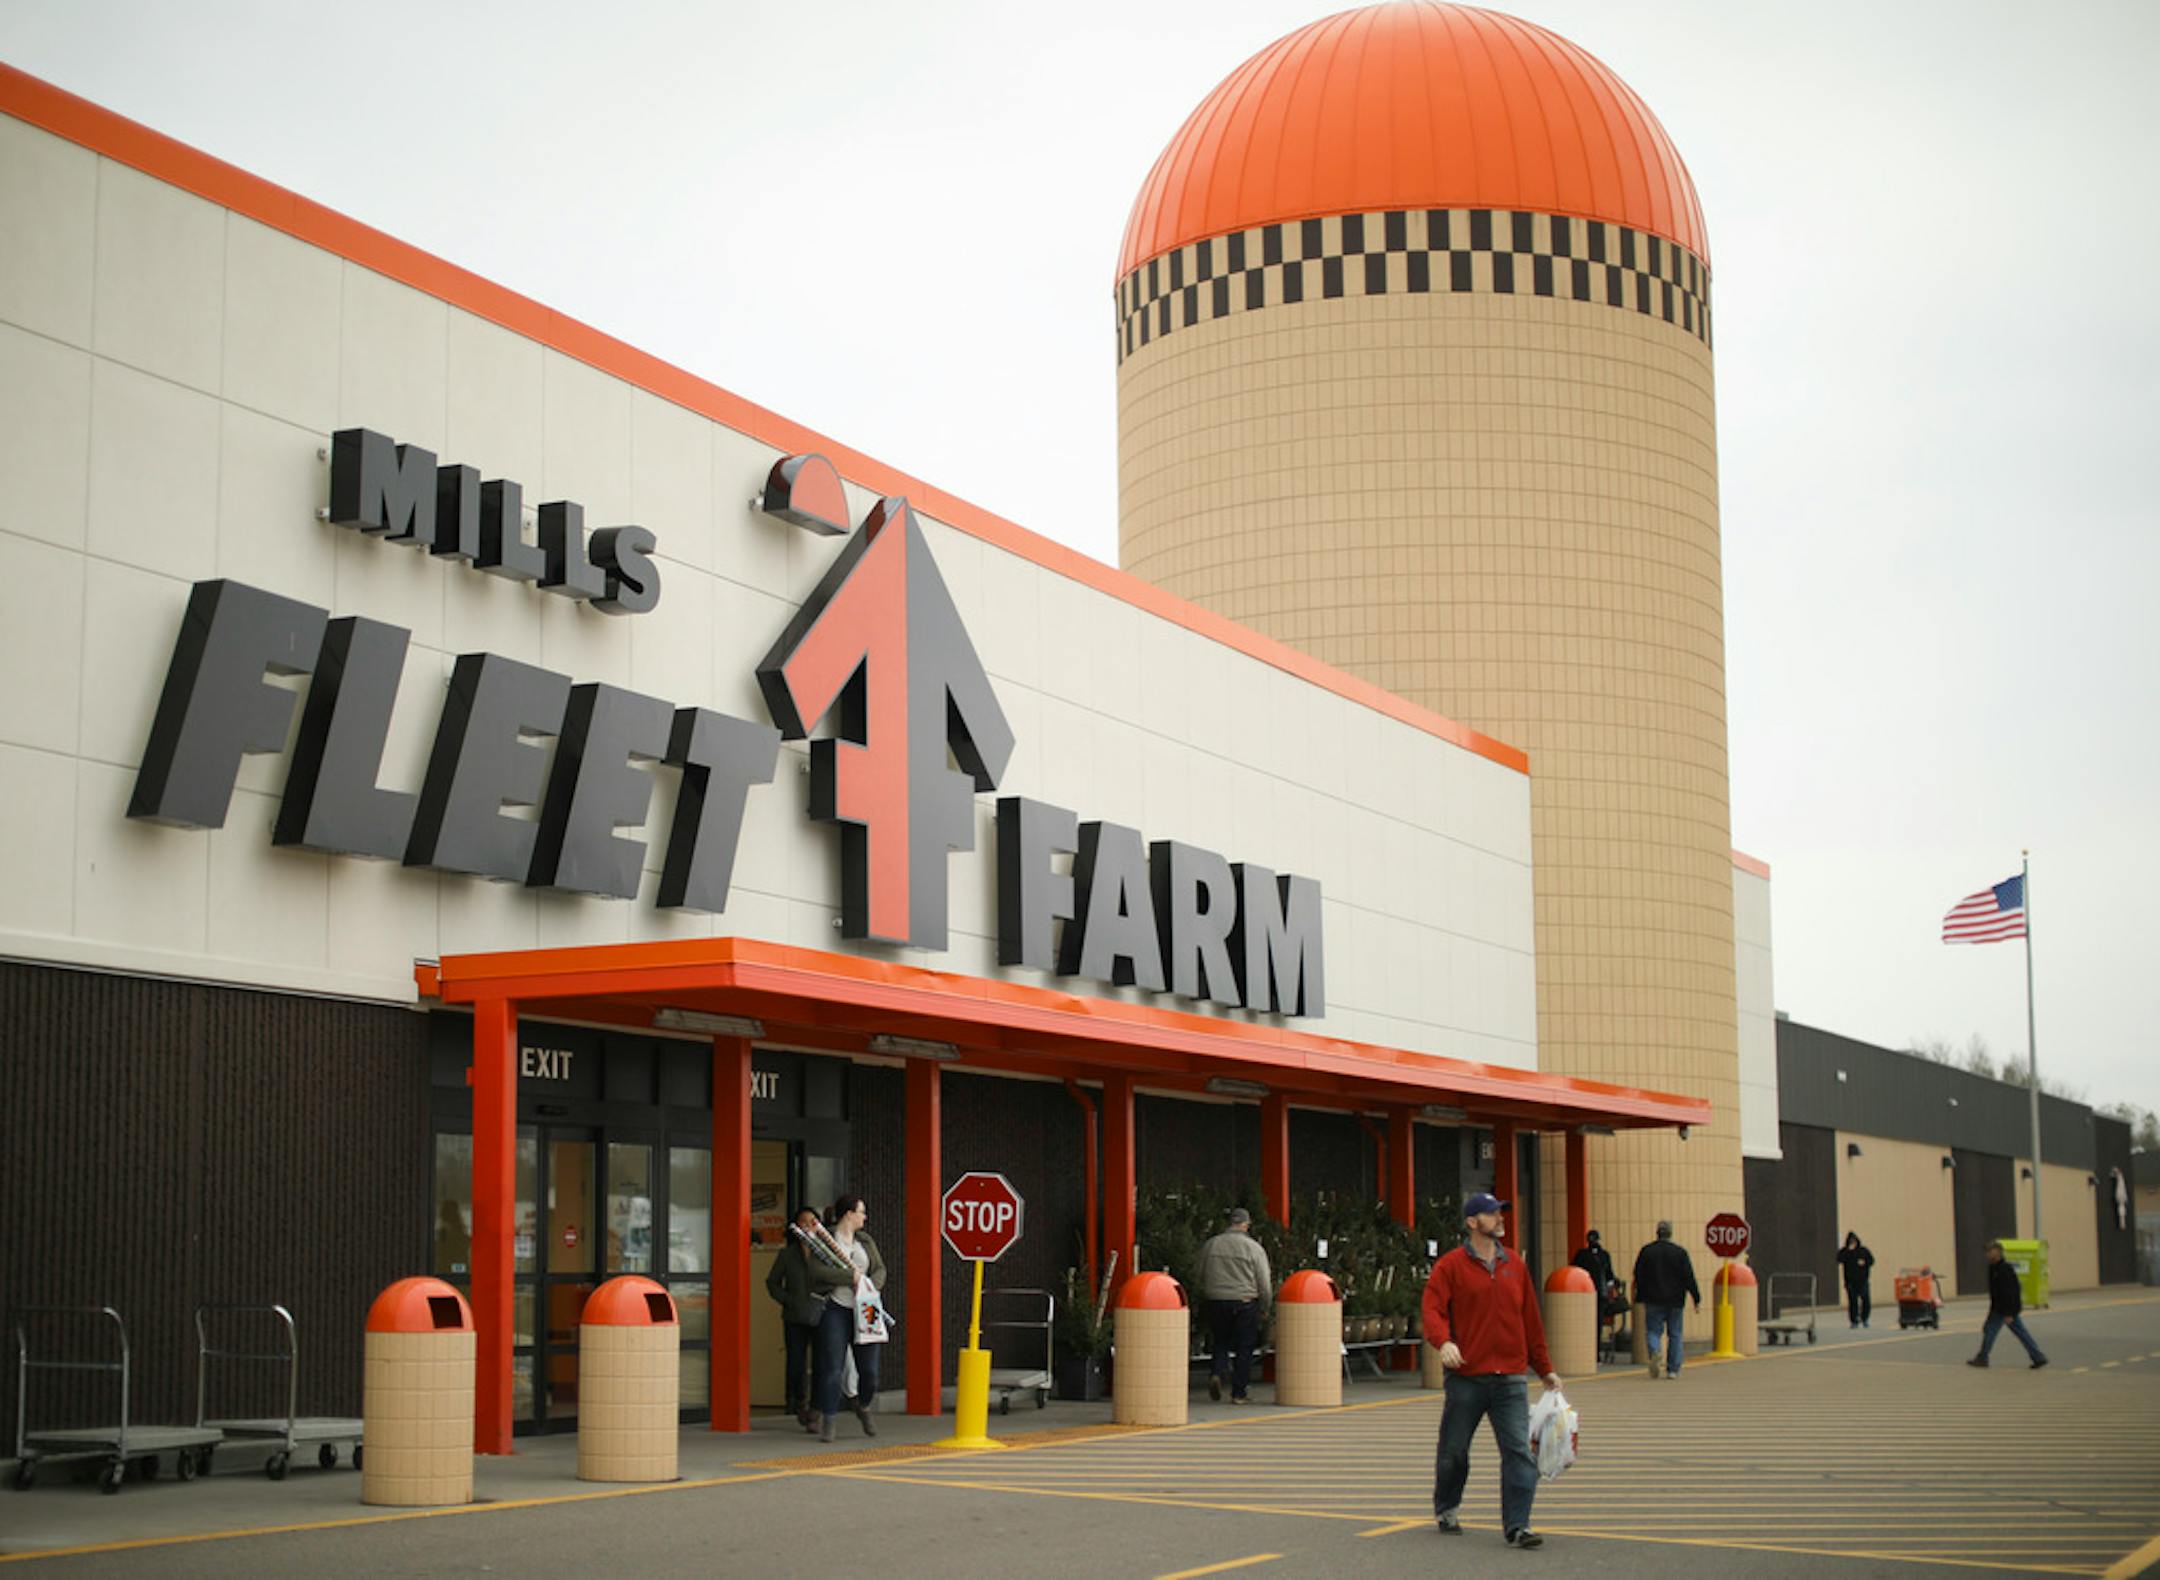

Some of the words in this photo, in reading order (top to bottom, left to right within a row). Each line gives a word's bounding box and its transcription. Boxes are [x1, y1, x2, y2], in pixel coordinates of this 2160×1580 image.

[329, 427, 661, 615] MILLS
[126, 578, 783, 915] FLEET
[996, 796, 1325, 1018] FARM
[521, 1047, 574, 1080] EXIT
[751, 1071, 780, 1099] XIT
[947, 1200, 1014, 1233] STOP
[1708, 1225, 1747, 1245] STOP
